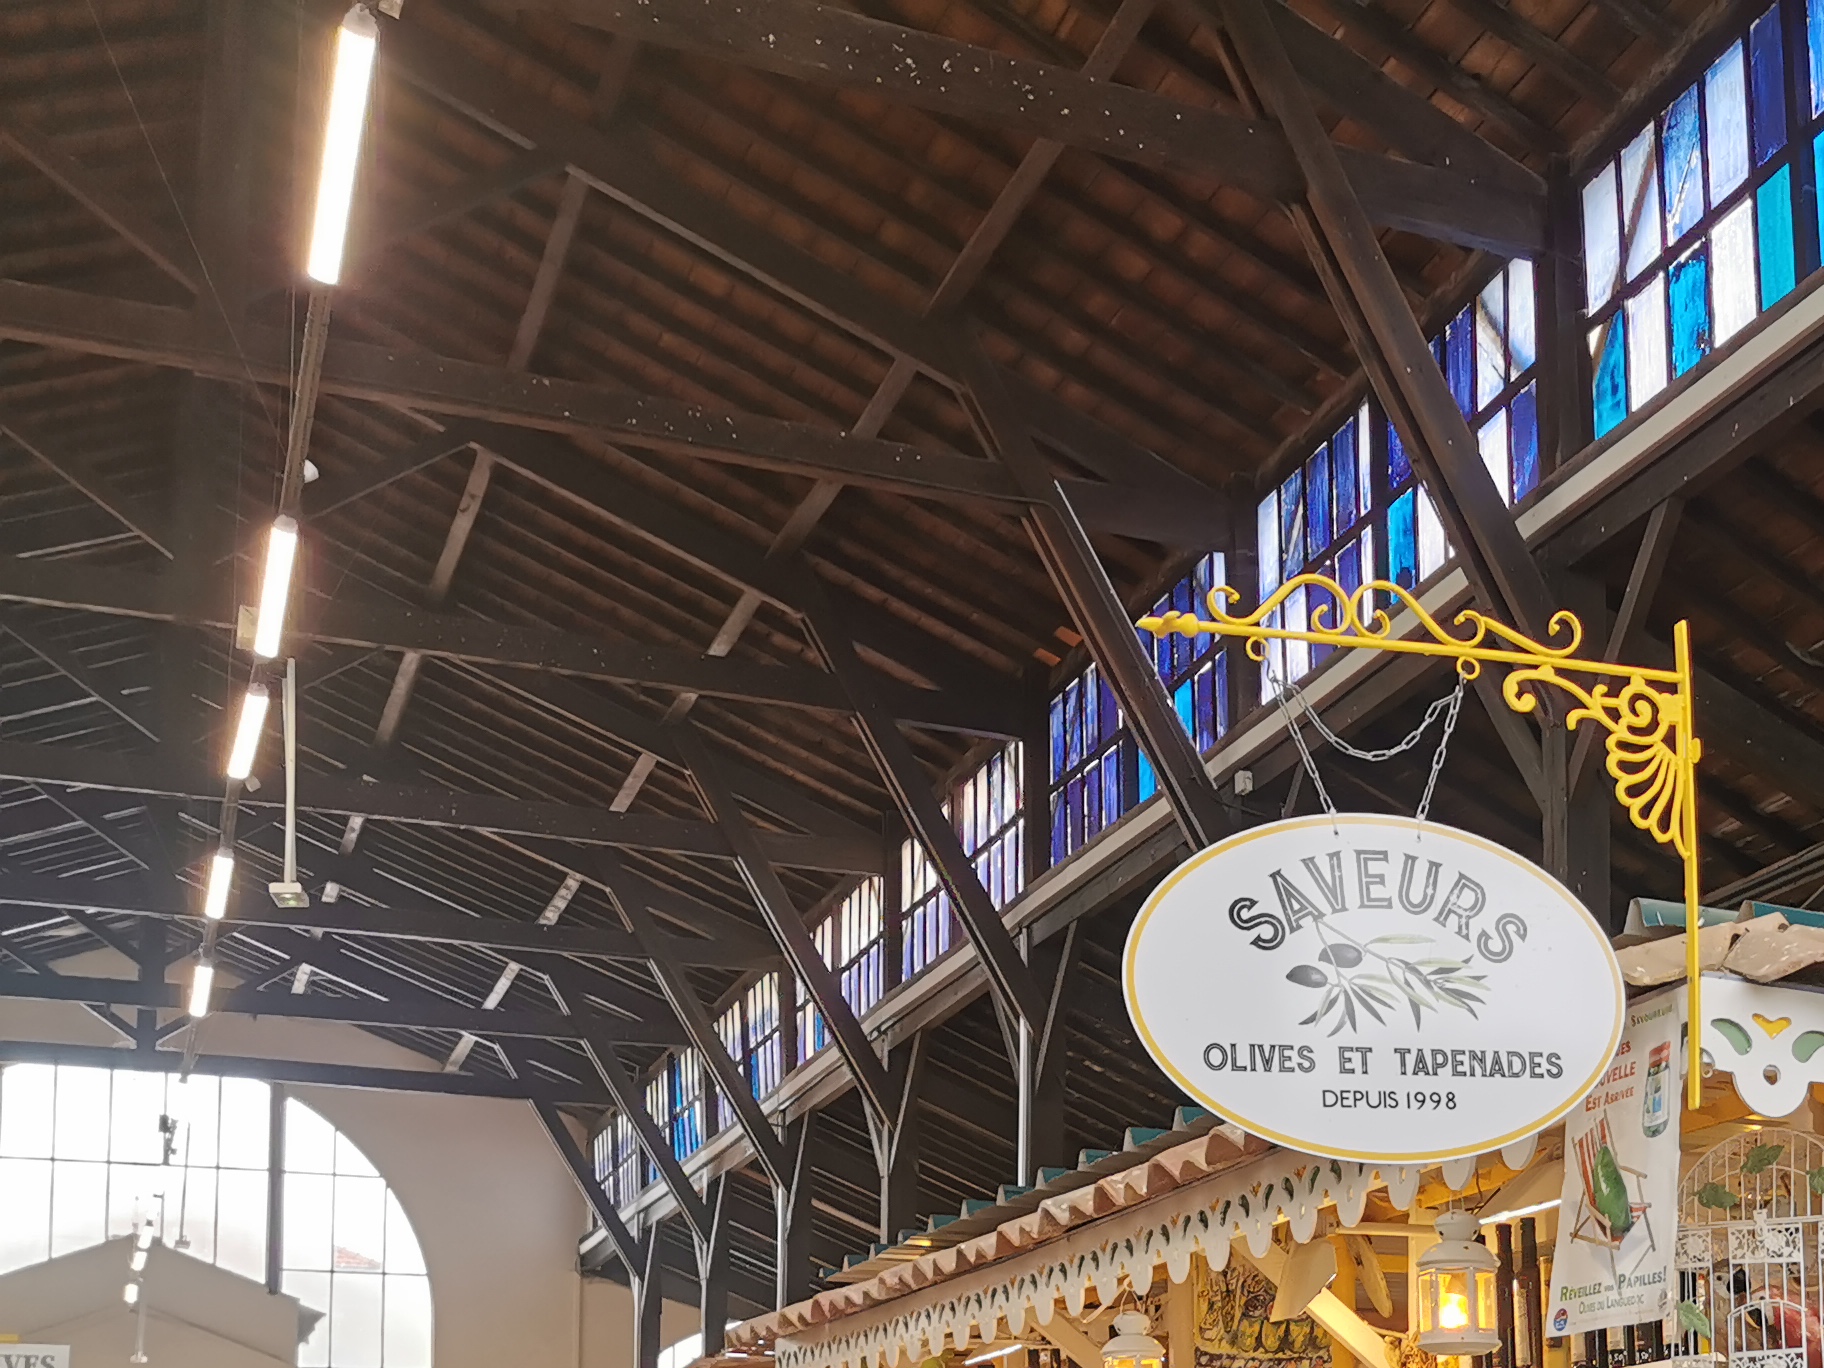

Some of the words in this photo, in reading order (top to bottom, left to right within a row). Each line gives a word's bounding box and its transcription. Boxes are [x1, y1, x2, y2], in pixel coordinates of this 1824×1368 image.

[1227, 848, 1529, 964] SAVEURS
[1202, 1041, 1317, 1073] OLIVES
[1338, 1046, 1373, 1075] ET
[1394, 1047, 1564, 1079] TAPENADES
[1322, 1089, 1399, 1109] DEPUIS
[1406, 1091, 1457, 1110] 1998
